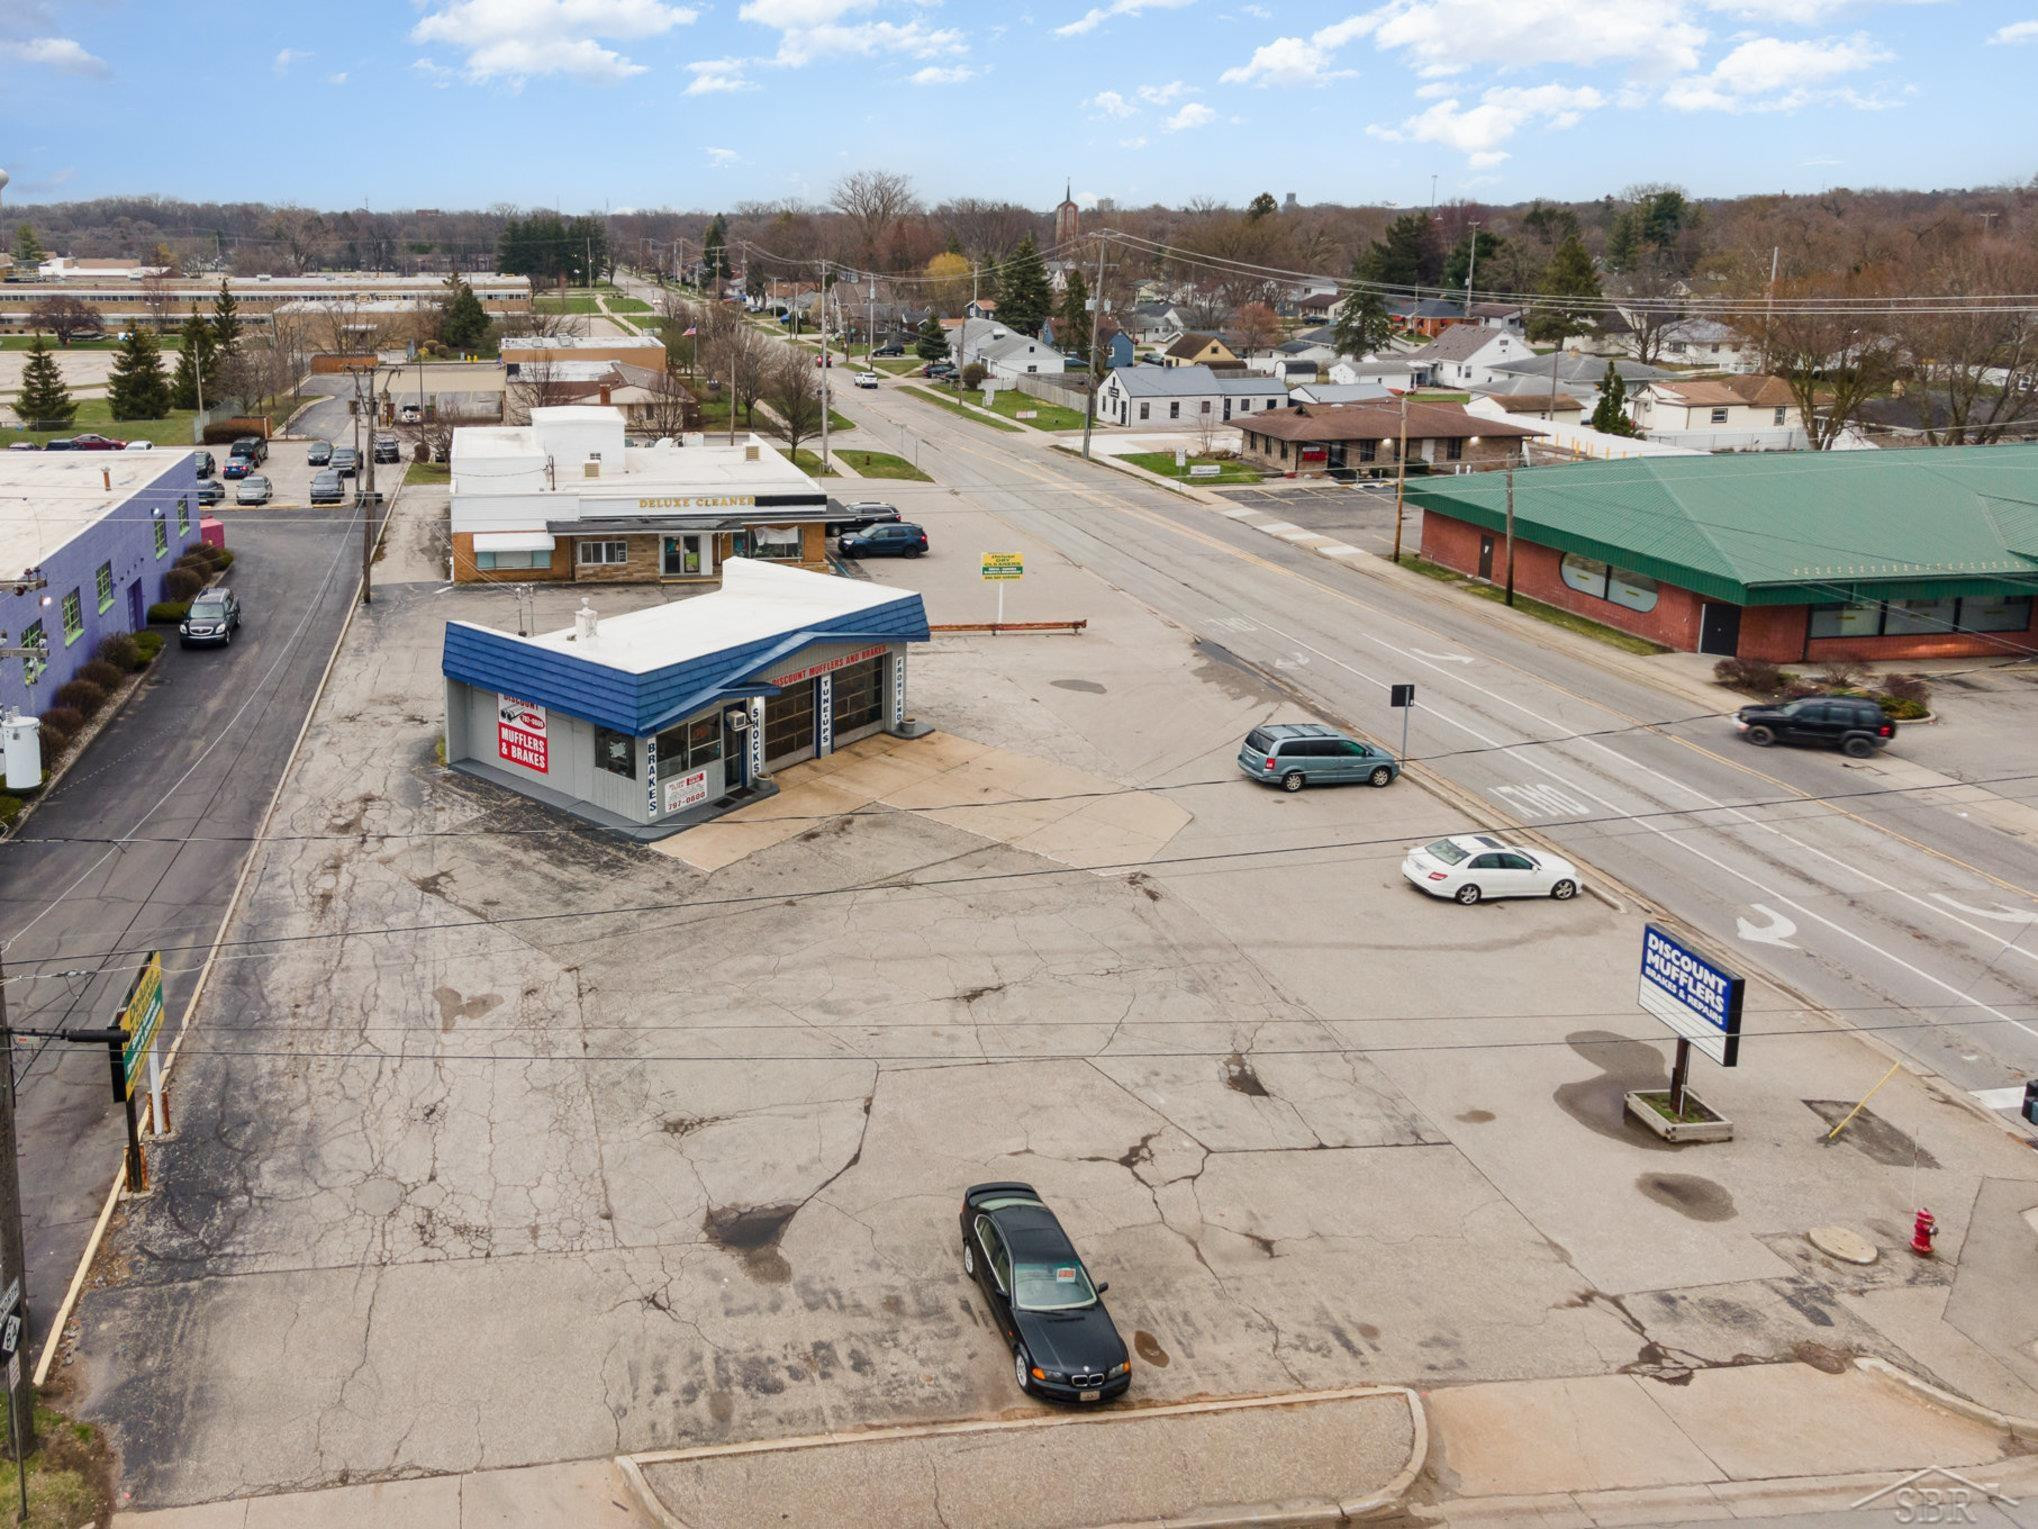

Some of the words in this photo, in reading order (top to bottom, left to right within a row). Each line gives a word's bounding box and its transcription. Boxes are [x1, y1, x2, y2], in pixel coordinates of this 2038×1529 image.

[639, 497, 690, 508] DELUXE
[696, 496, 755, 507] CLEANER
[771, 670, 806, 686] DISCOUNT
[809, 658, 843, 676] MUFFLERS
[846, 653, 859, 665] AND
[861, 645, 887, 659] BRAKES
[501, 727, 545, 754] MUFFLERS
[752, 708, 760, 773] SHOCKS
[822, 680, 830, 743] TUNE-UPS
[501, 742, 508, 755] &
[511, 745, 546, 768] BRAKES
[647, 742, 657, 811] BRAKES
[1487, 784, 1590, 818] ONLY
[1646, 950, 1725, 1013] MUFFLERS
[1647, 932, 1728, 994] DISCOUNT
[1645, 966, 1677, 994] BRAKES
[1678, 988, 1686, 1000] &
[1687, 994, 1723, 1025] REPAIRS
